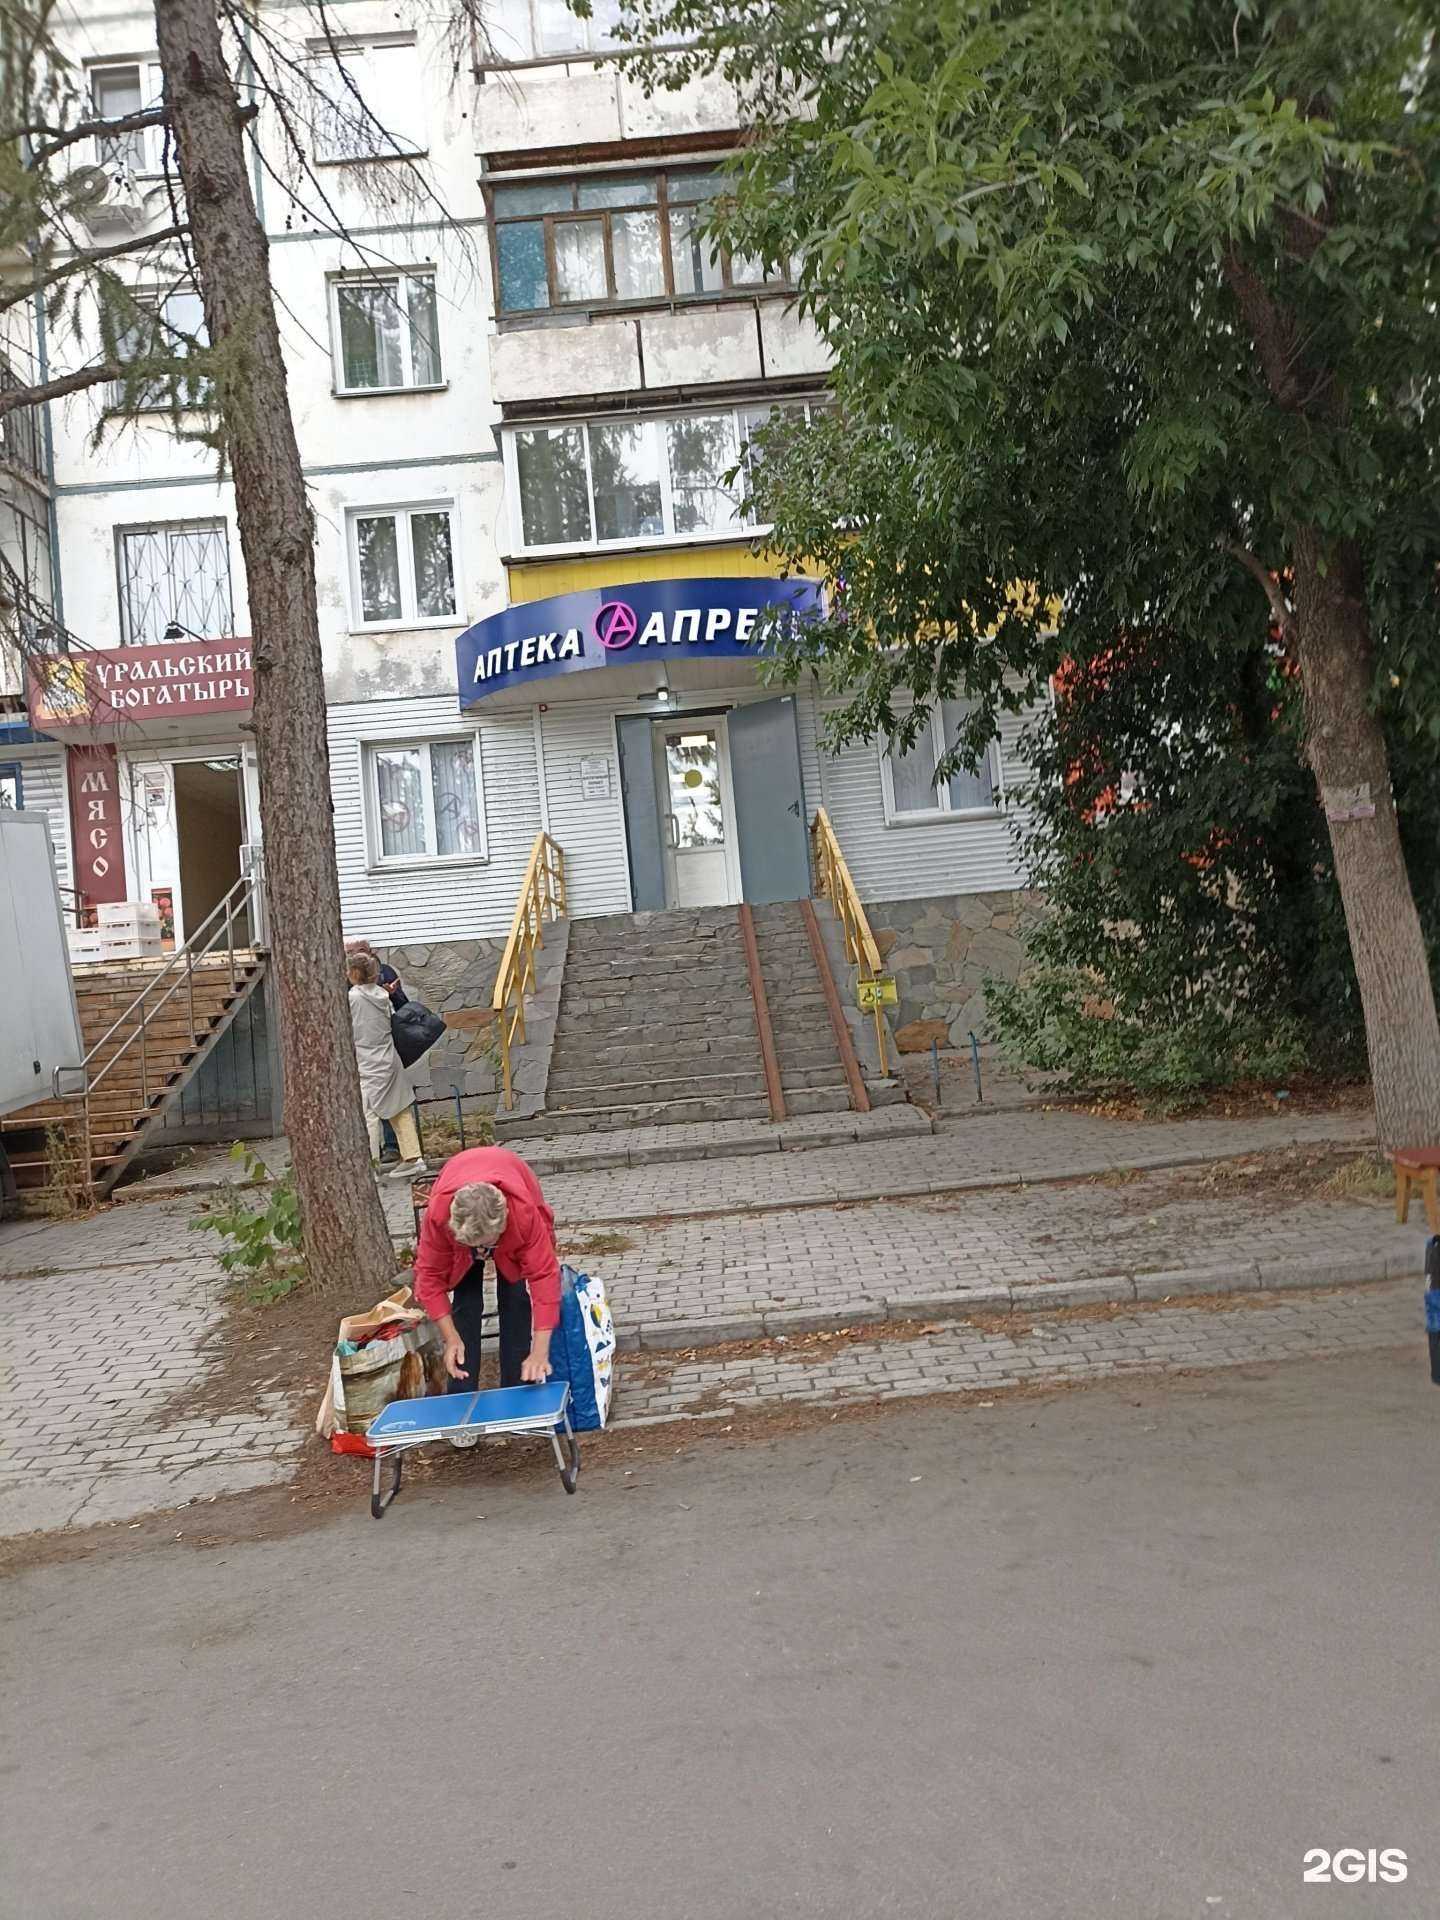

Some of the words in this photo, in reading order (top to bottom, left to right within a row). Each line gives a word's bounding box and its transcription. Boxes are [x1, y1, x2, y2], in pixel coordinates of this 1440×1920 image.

[95, 647, 251, 688] УРАЛЬСКИЙ
[473, 628, 581, 683] АПТЕКА
[638, 607, 807, 645] АПРЕЛ
[110, 678, 249, 709] БОГАТЫРЬ
[80, 770, 110, 877] МЯСО
